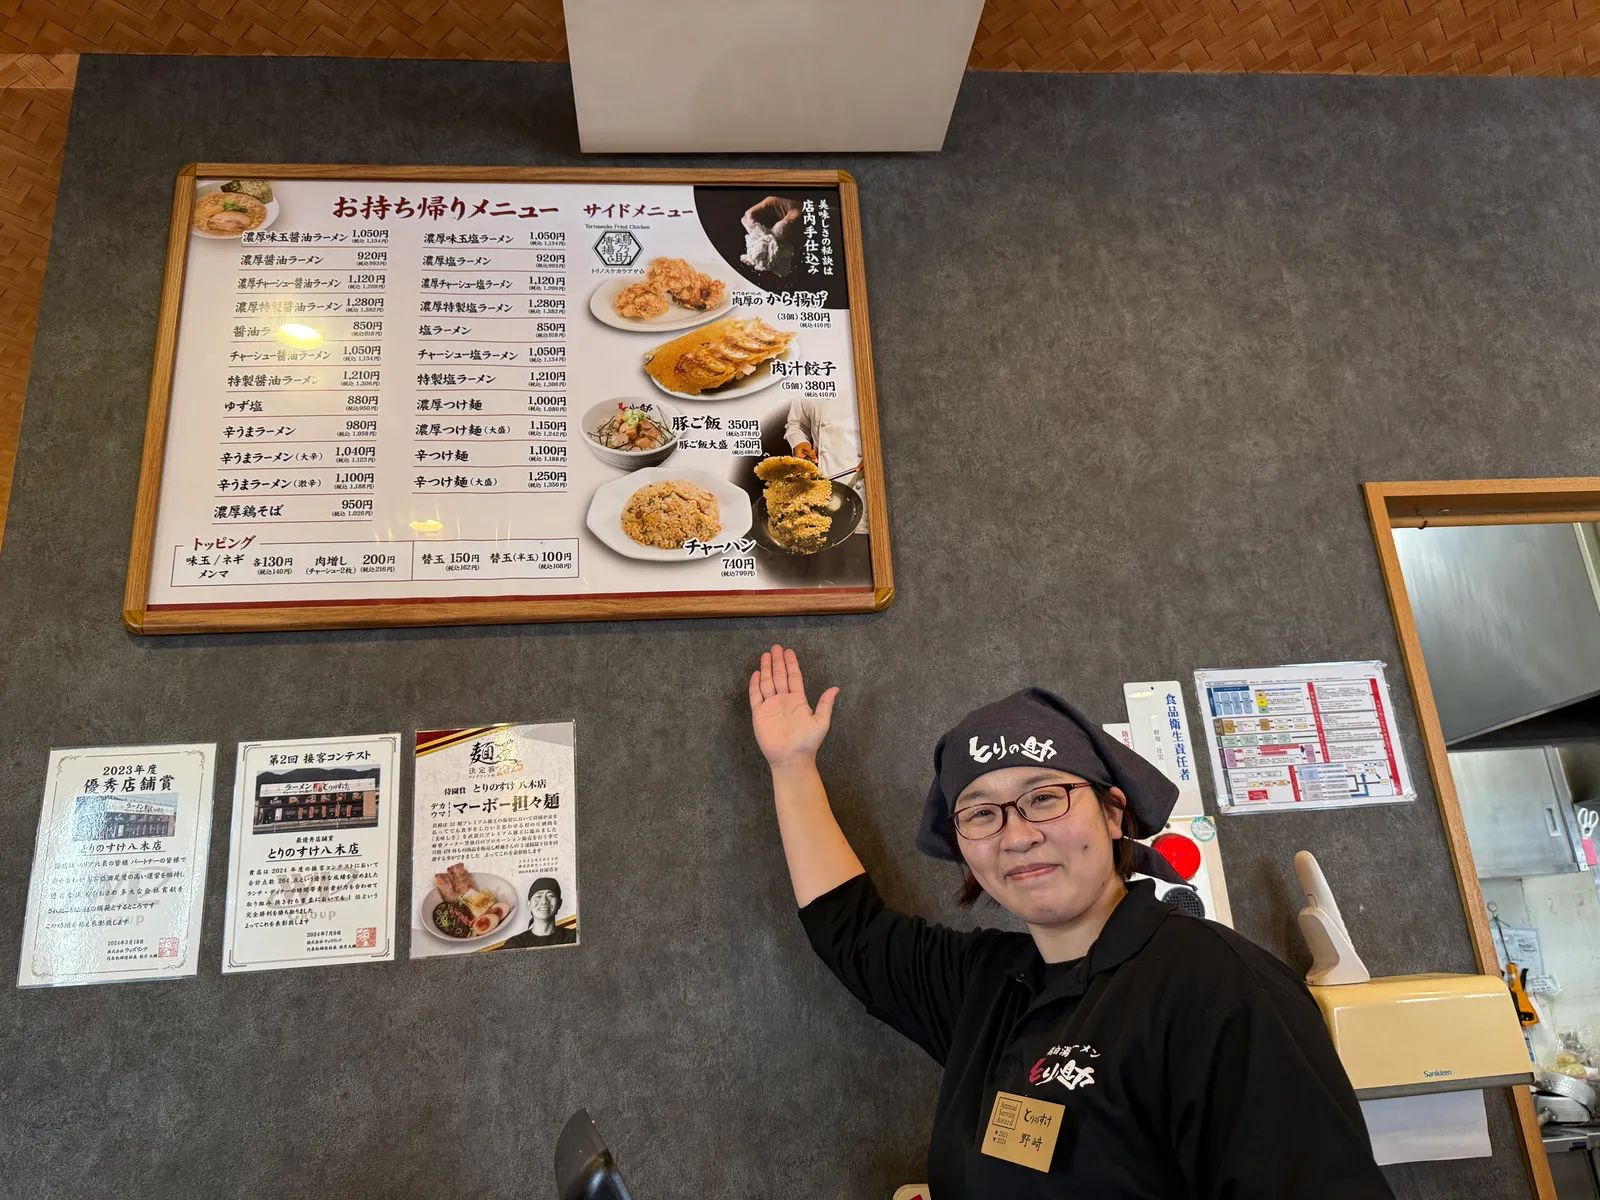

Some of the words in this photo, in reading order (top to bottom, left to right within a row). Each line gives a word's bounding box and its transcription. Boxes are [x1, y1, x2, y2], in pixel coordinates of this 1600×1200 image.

[332, 195, 559, 221] お持ち帰りメニュー
[583, 203, 694, 218] サイドメニュー
[243, 231, 348, 243] 濃厚味玉醤油ラーメン
[352, 229, 389, 238] 1,050円
[423, 233, 515, 244] 濃厚味玉塩ラーメン
[529, 231, 566, 241] 1,050円
[802, 199, 820, 275] 店内手仕込み
[818, 199, 834, 276] 美味しさの秘訣は
[240, 254, 324, 266] 濃厚醤油ラーメン
[357, 252, 387, 261] 920円
[422, 255, 492, 266] 濃厚塩ラーメン
[536, 254, 566, 263] 920円
[348, 274, 386, 284] 1,120円
[421, 277, 514, 290] 濃厚チャーシュー塩ラーメン
[528, 276, 566, 286] 1,120円
[346, 298, 384, 307] 1,280円
[420, 301, 514, 313] 濃厚特製塩ラーメン
[528, 299, 566, 309] 1,280円
[732, 296, 763, 307] 肉厚の
[766, 291, 827, 308] から揚げ
[800, 312, 830, 322] 380円
[353, 321, 382, 331] 850円
[418, 324, 472, 336] 塩ラーメン
[536, 322, 566, 332] 850円
[343, 346, 381, 355] 1,050円
[417, 349, 518, 361] チャーシュー塩ラーメン
[528, 347, 566, 356] 1,050円
[343, 371, 380, 380] 1,210円
[771, 361, 837, 377] 肉汁餃子
[417, 373, 497, 385] 特製塩ラーメン
[530, 372, 566, 381] 1,210円
[805, 381, 836, 392] 380円
[224, 399, 264, 412] ゆず塩
[347, 395, 379, 405] 880円
[416, 398, 483, 411] 濃厚つけ麺
[528, 396, 566, 406] 1,000円
[222, 426, 296, 438] 辛うまラーメン
[346, 420, 377, 430] 980円
[530, 421, 567, 431] 1,150円
[671, 415, 721, 431] 豚ご飯
[727, 420, 759, 430] 350円
[335, 446, 376, 456] 1,040円
[678, 439, 728, 450] 豚ご飯大盛
[733, 440, 760, 449] 450円
[414, 449, 470, 462] 辛つけ麺
[529, 446, 567, 456] 1,100円
[335, 473, 374, 483] 1,100円
[528, 471, 567, 482] 1,250円
[214, 504, 284, 519] 濃厚鶏そば
[341, 499, 373, 510] 950円
[193, 535, 257, 551] トッピング
[684, 539, 757, 555] チャーハン
[253, 556, 293, 568] 各130円
[315, 556, 348, 567] 肉増し
[363, 554, 396, 565] 200円
[421, 553, 446, 565] 替玉
[450, 552, 480, 563] 150円
[541, 551, 572, 562] 100円
[722, 558, 755, 569] 740円
[198, 569, 229, 580] メンマ
[1165, 693, 1191, 781] 食品衛生責任者
[269, 754, 299, 766] 第2回
[302, 750, 372, 764] 接客コンテスト
[103, 764, 158, 776] 2023年度
[83, 775, 175, 794] 優秀店舗賞
[80, 840, 162, 854] とりのすけ八木店
[268, 842, 360, 859] とりのすけ八木店
[1024, 1108, 1052, 1128] とりのすけ
